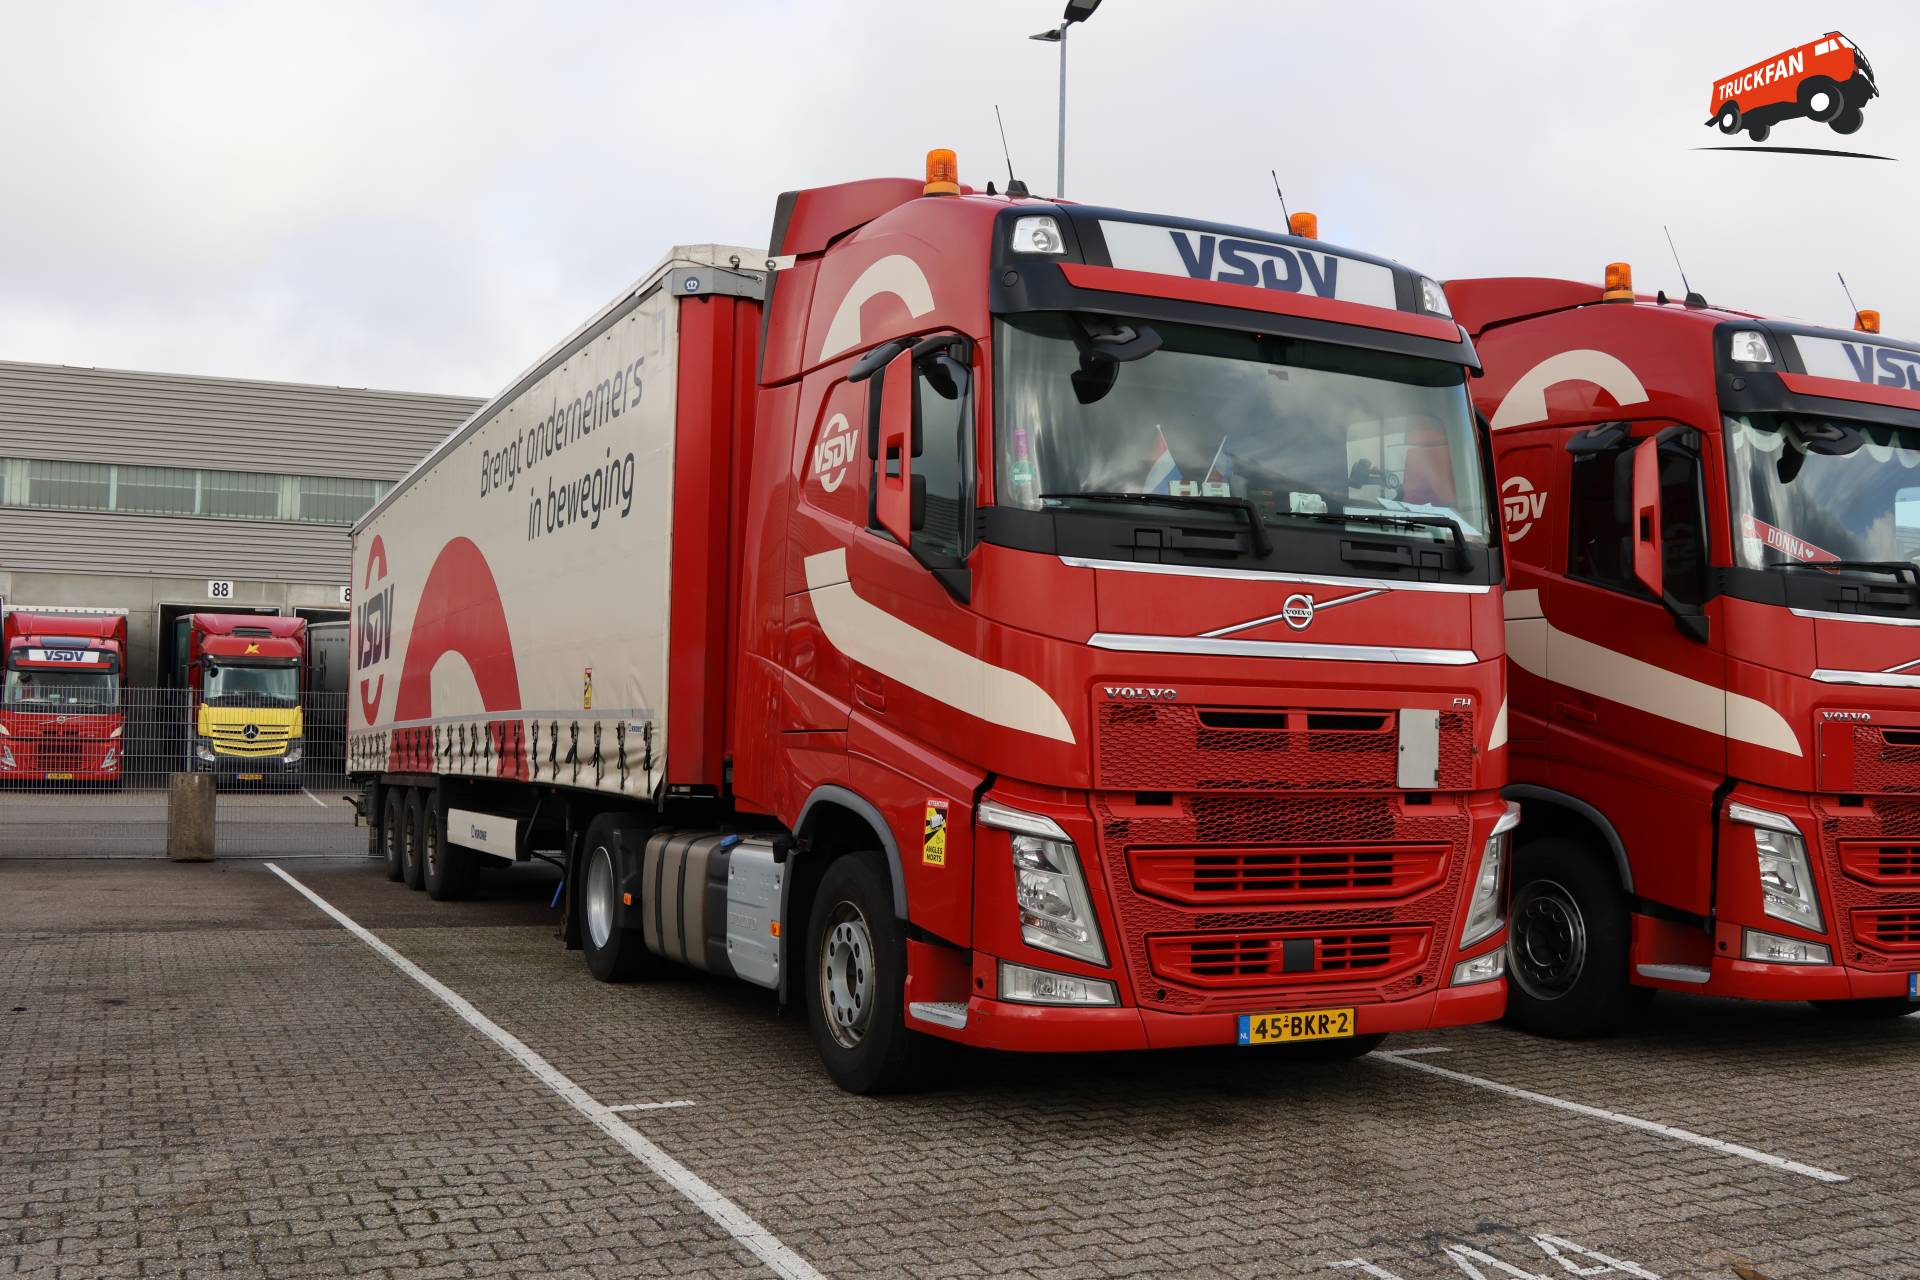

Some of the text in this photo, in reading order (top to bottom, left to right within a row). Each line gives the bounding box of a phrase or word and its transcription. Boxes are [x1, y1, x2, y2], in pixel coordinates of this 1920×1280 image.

[1169, 231, 1338, 300] VSDV
[480, 356, 645, 498] Brengt ondernemers
[815, 429, 858, 474] VSDV
[528, 447, 635, 542] in beweging
[1767, 527, 1804, 559] DONNA
[213, 582, 228, 597] 88
[357, 583, 395, 671] VSDV
[43, 650, 84, 661] VSDV
[1103, 686, 1177, 700] VOLVO
[1452, 697, 1472, 708] FH
[1822, 711, 1871, 722] VOLVO
[926, 845, 943, 855] ANGLES
[926, 853, 942, 863] MORTS
